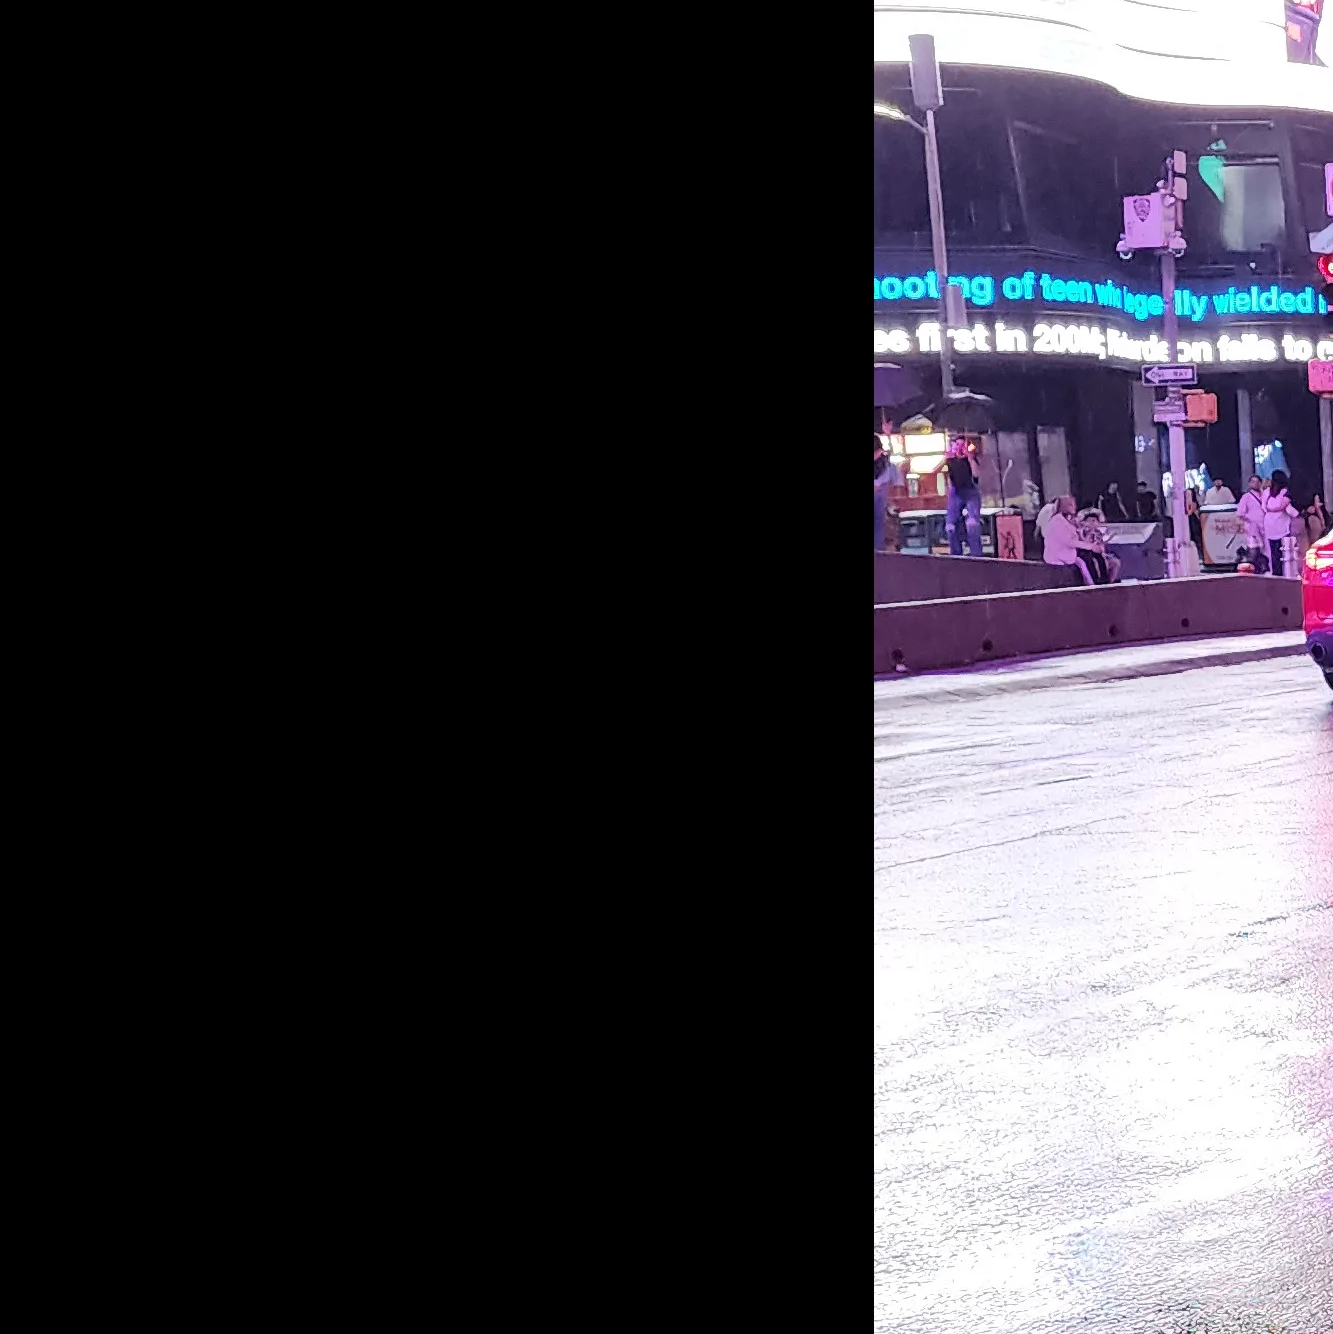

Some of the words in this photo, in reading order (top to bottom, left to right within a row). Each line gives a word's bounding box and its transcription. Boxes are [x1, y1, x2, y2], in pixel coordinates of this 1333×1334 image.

[1002, 270, 1035, 300] of
[1039, 272, 1094, 304] teen
[1212, 284, 1316, 315] wielded
[915, 322, 993, 354] first
[994, 319, 1030, 353] in
[1281, 333, 1314, 362] to
